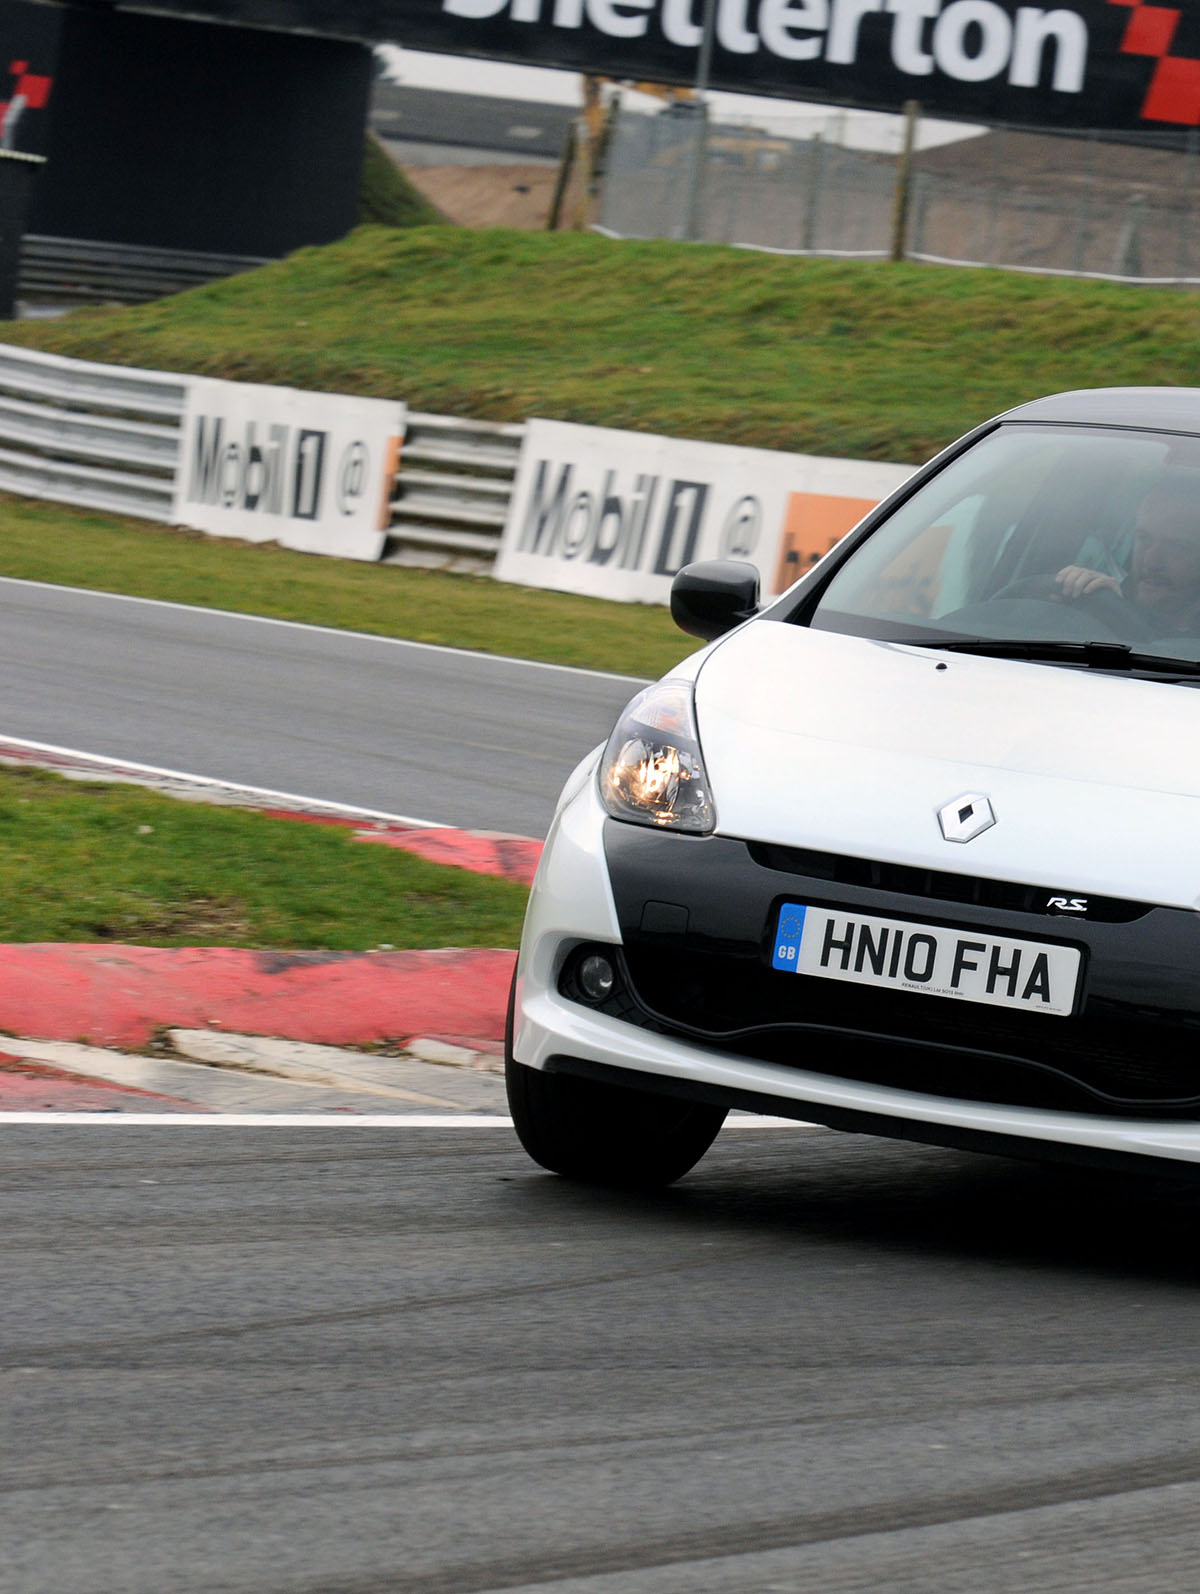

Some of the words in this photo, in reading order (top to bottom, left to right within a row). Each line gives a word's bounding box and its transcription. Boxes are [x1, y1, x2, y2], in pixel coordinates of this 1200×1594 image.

[517, 458, 660, 572] Mobil
[778, 945, 796, 960] GB
[820, 918, 938, 983] HN10
[950, 939, 1051, 1003] FHA
